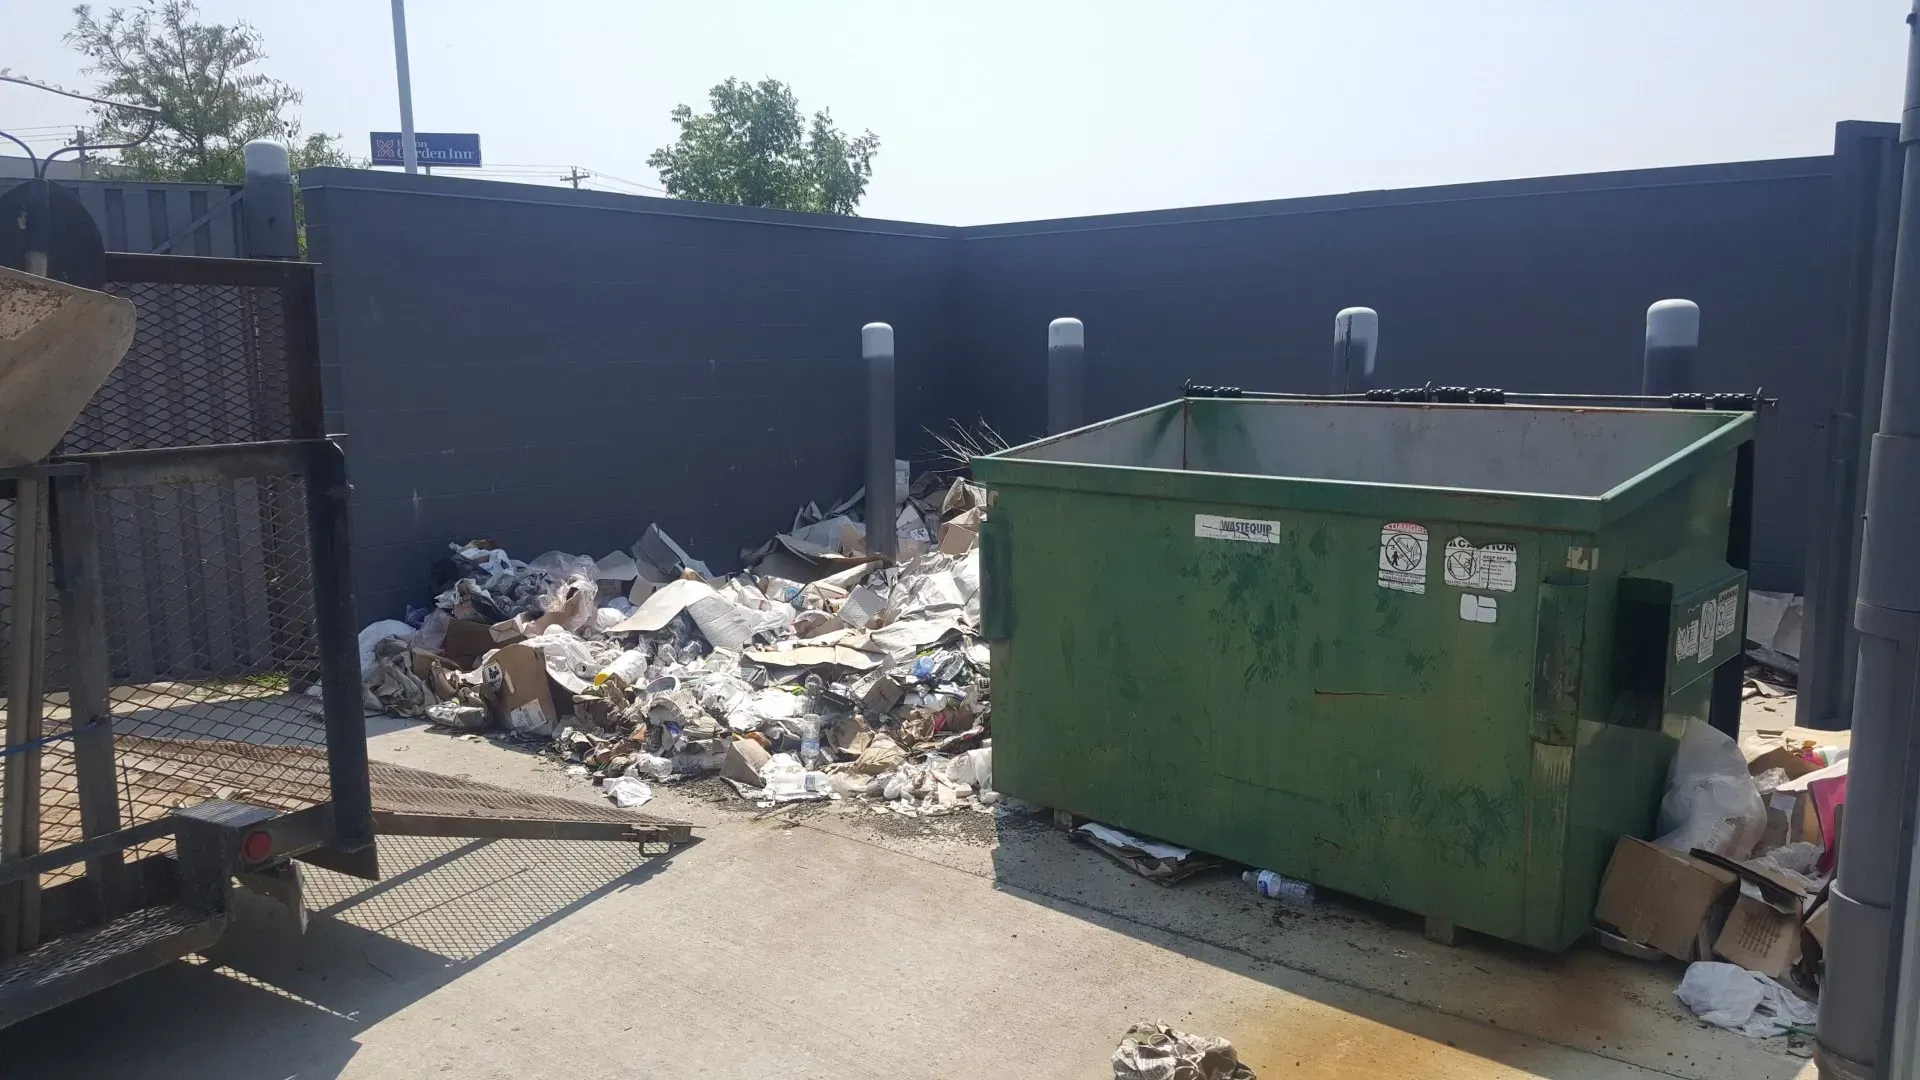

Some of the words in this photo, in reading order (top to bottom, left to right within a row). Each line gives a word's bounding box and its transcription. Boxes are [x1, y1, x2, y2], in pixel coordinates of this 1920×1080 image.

[396, 148, 448, 159] Grden
[449, 149, 473, 160] Inn
[1221, 520, 1272, 535] WASTEQUIP
[1458, 539, 1515, 552] CTION
